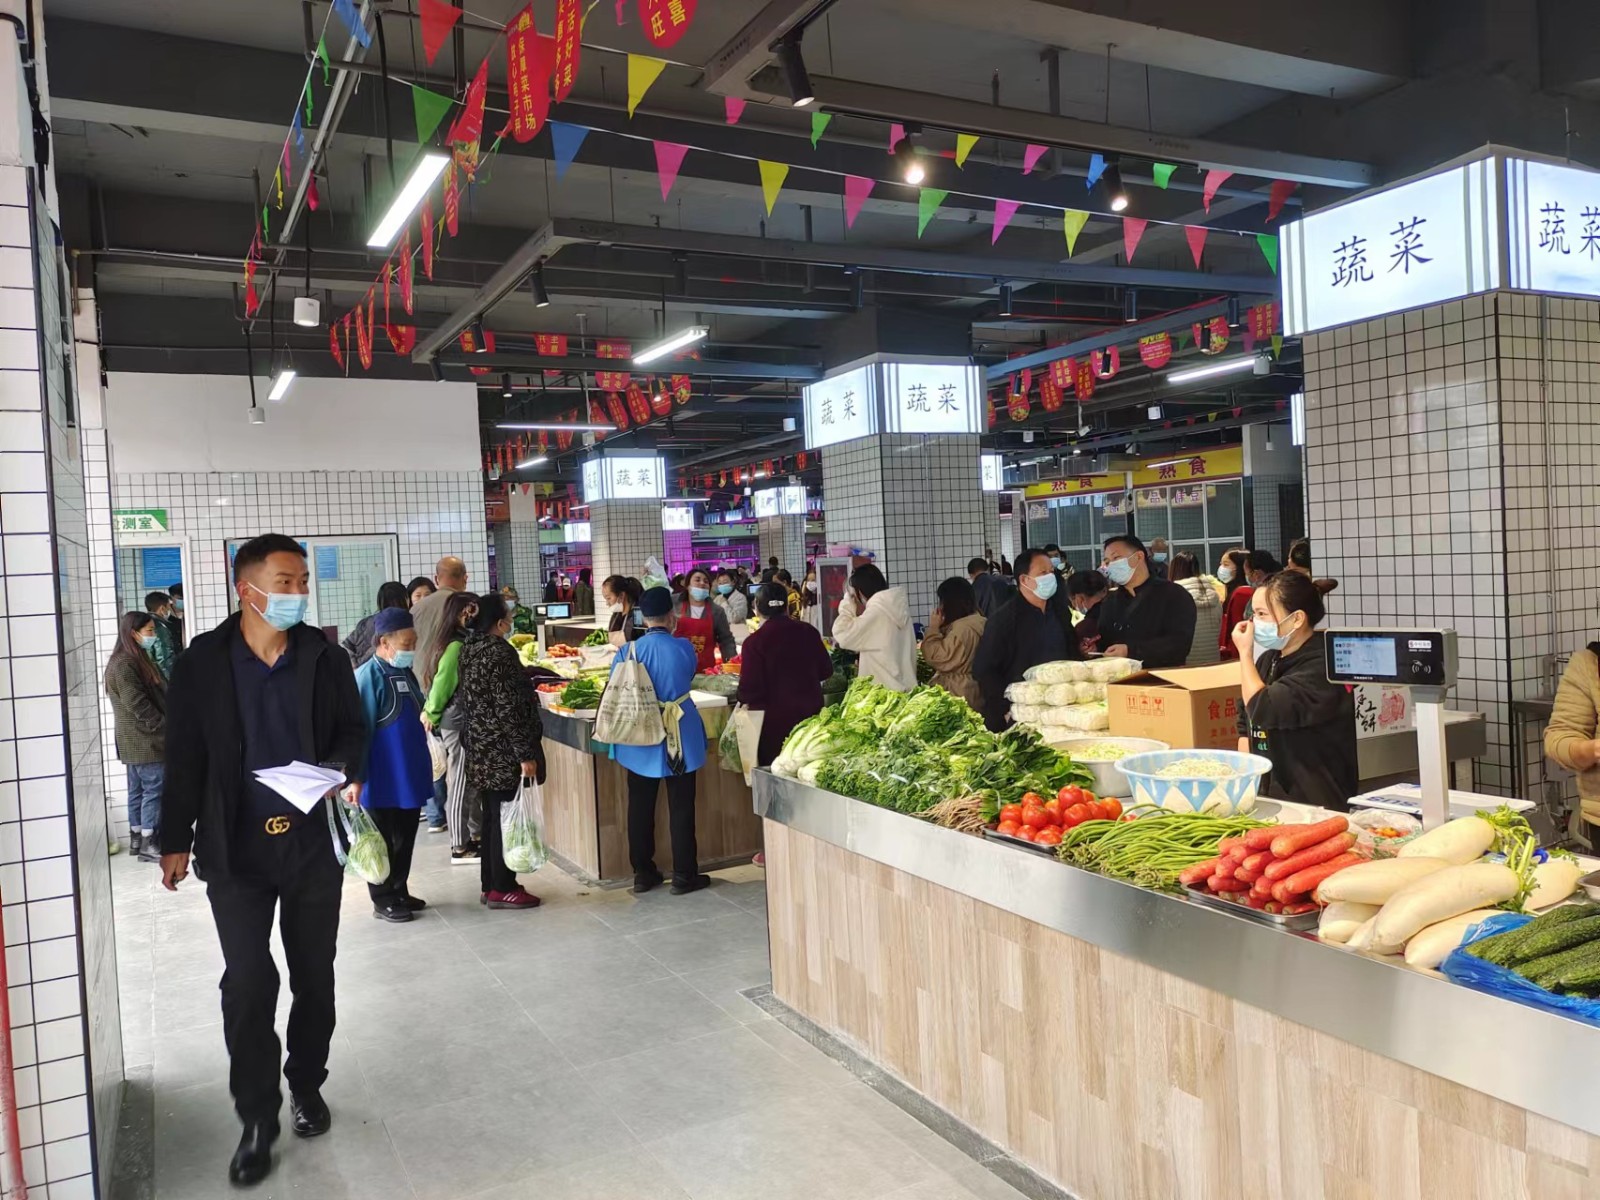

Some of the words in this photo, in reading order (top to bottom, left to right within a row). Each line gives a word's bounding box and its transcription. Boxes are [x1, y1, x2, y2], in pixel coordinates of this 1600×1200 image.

[1538, 201, 1600, 261] 蔬菜
[1331, 216, 1433, 288] 蔬菜
[821, 391, 856, 426] 蔬菜
[907, 383, 960, 414] 蔬菜
[616, 468, 652, 487] 蔬菜
[1208, 698, 1236, 720] 食品
